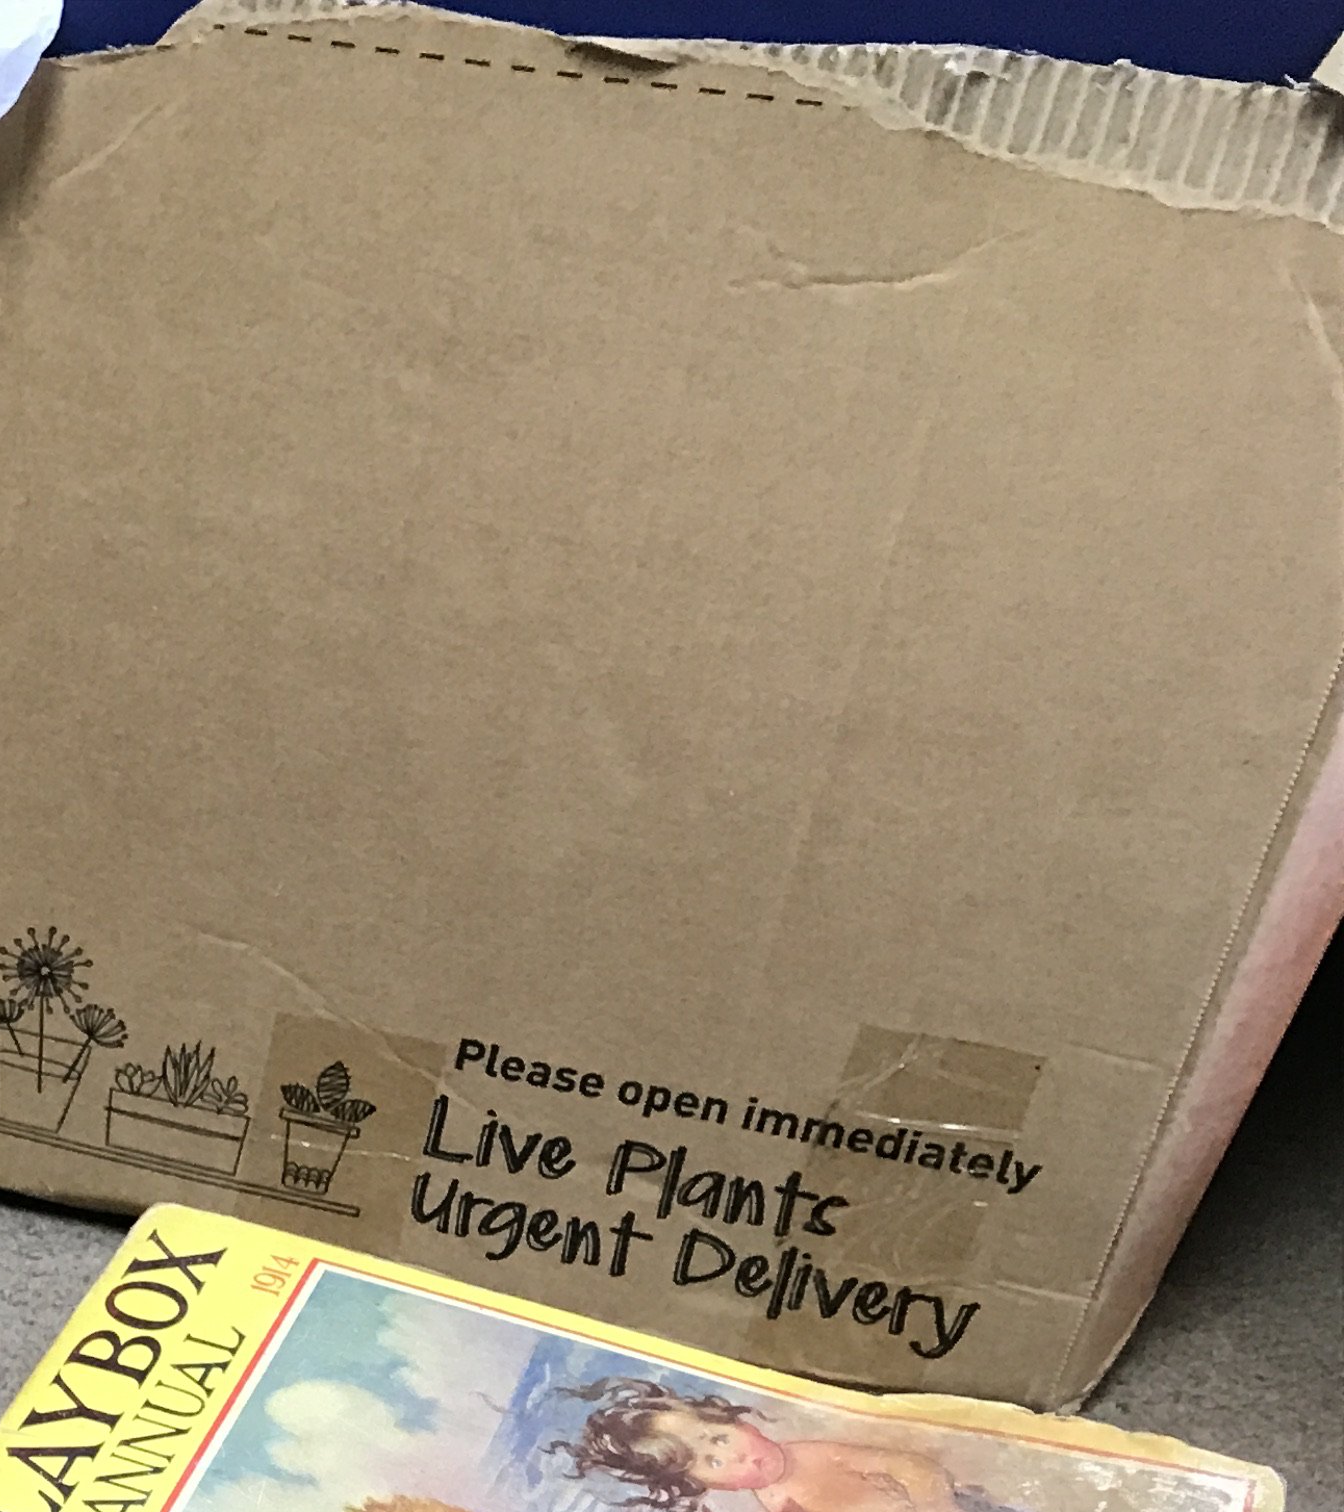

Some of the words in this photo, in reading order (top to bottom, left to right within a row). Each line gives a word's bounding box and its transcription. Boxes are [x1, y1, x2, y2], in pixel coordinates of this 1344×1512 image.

[422, 1095, 576, 1179] Live
[606, 1139, 850, 1238] Plants
[455, 1038, 604, 1099] Please
[617, 1079, 729, 1125] open
[741, 1097, 1044, 1194] immediately
[250, 1254, 300, 1296] 1914
[410, 1172, 654, 1277] Urgent
[673, 1228, 980, 1359] Delivery
